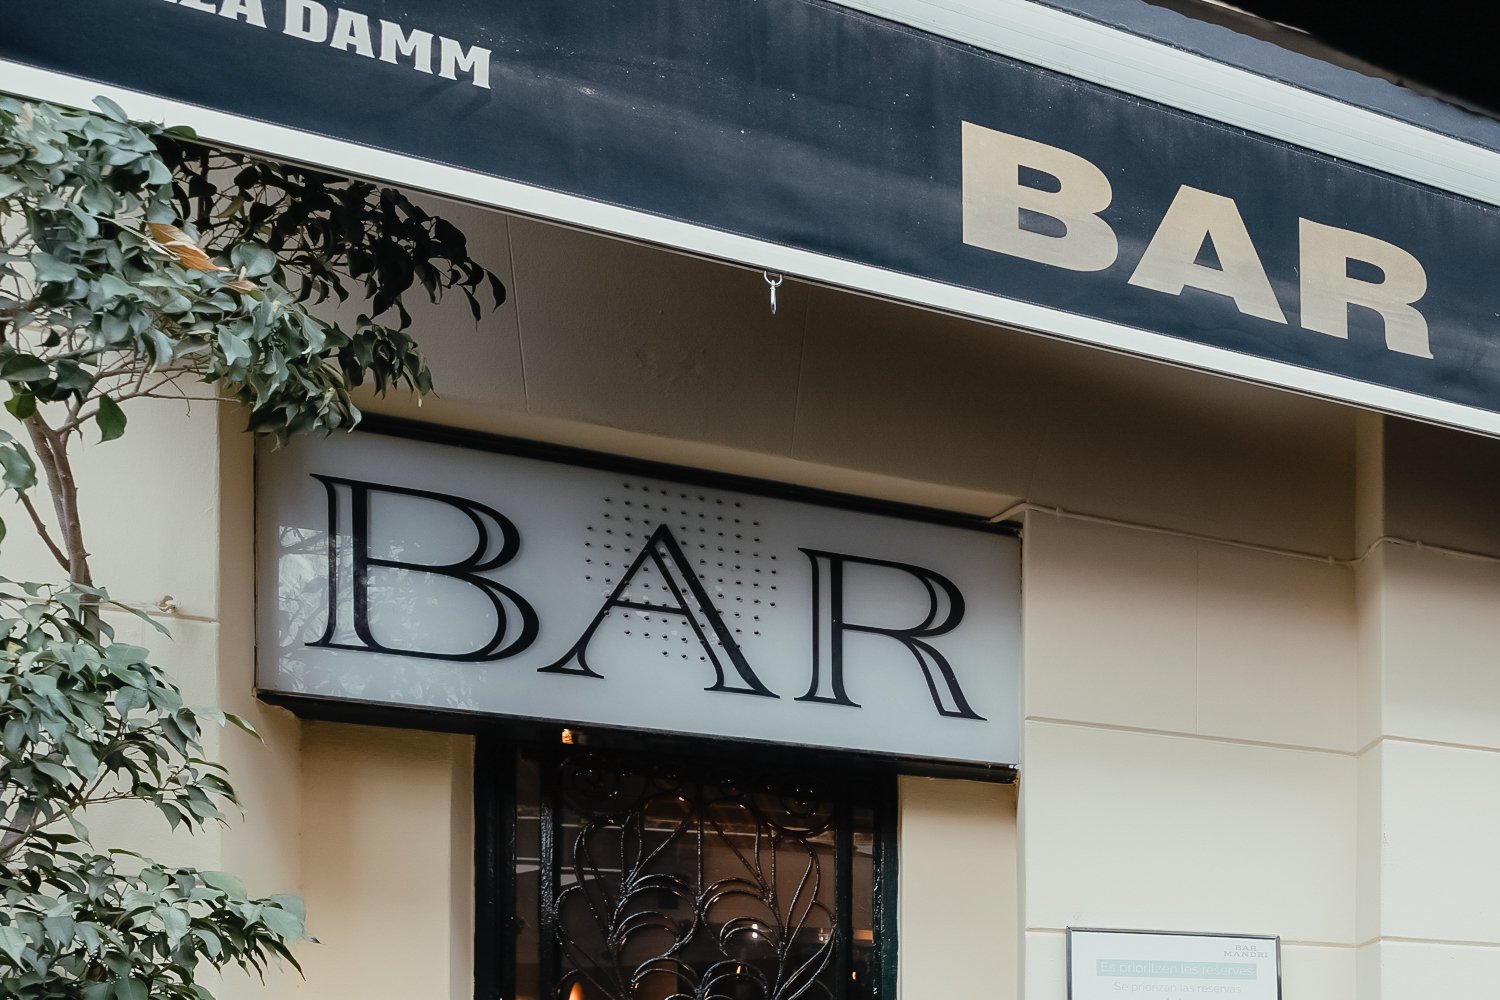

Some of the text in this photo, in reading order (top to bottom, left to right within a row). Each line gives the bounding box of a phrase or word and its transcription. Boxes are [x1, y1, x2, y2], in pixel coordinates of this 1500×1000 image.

[282, 0, 492, 89] DAMM
[961, 120, 1434, 359] BAR
[304, 473, 988, 721] BAR
[1100, 961, 1116, 973] Es
[1223, 950, 1268, 958] MANDRI
[1114, 981, 1242, 995] Se priorizan las reservas
